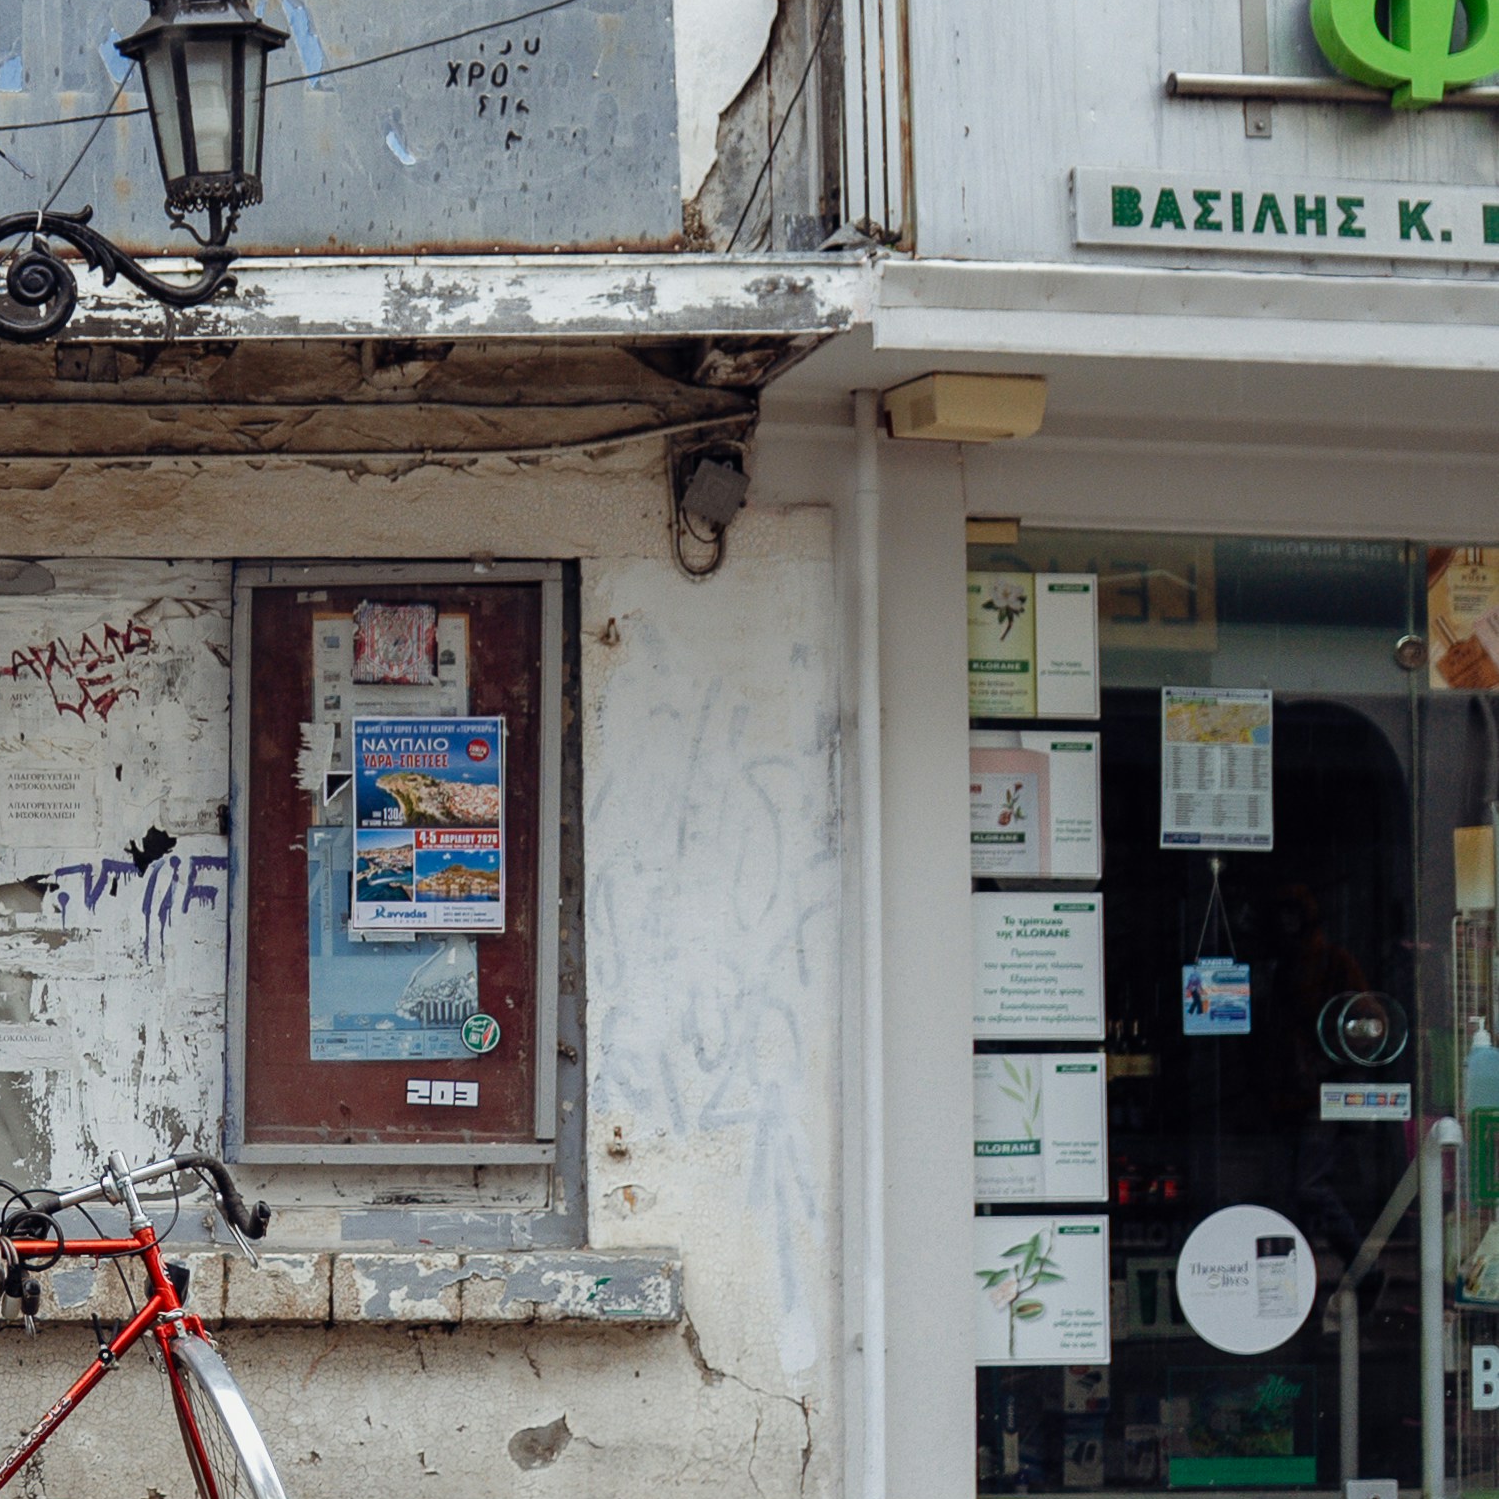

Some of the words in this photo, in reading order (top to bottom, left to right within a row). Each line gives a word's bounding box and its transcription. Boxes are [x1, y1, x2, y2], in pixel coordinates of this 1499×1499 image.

[1110, 184, 1367, 239] ΒΑΣΙΛΗΣ
[1398, 198, 1453, 243] Κ.
[361, 737, 449, 752] ΝΑΥΠΛΙΟ
[362, 753, 449, 768] ΥΔΡΑ-ΣΠΕΤΣΕΣ
[418, 831, 437, 844] 4-5
[439, 834, 475, 844] ΑΠΡΙΛΙΟΥ
[1015, 928, 1071, 938] KLORANE
[407, 1078, 479, 1107] 203
[976, 1142, 1036, 1155] KLORANE
